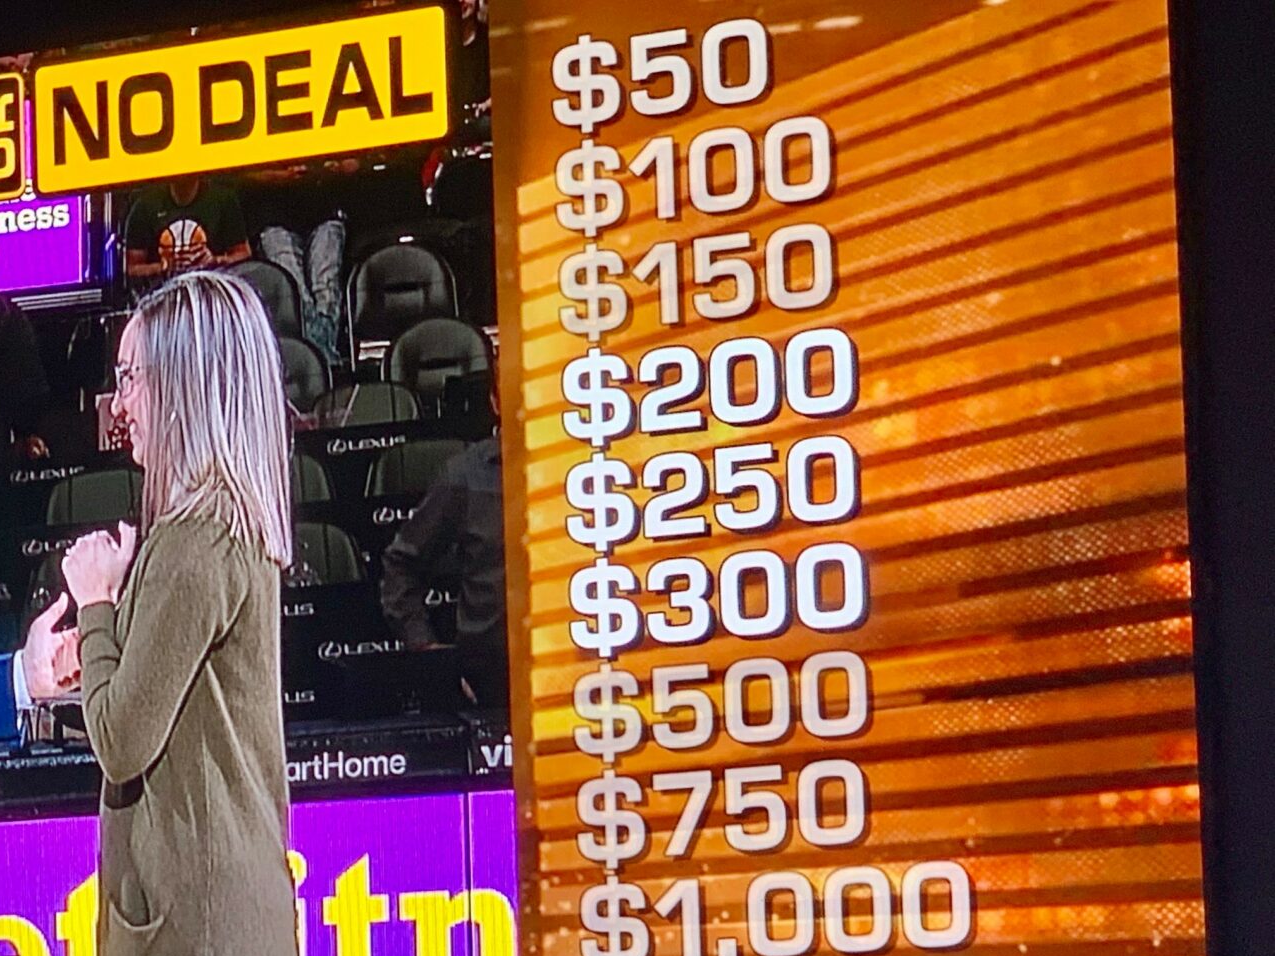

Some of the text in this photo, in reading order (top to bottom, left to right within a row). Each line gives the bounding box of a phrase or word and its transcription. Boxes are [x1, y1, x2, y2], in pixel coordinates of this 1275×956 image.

[52, 71, 175, 166] NO
[199, 34, 435, 144] DEAL
[550, 18, 769, 132] $50
[554, 115, 833, 237] $100
[557, 223, 835, 341] $150
[561, 328, 857, 446] $200
[564, 435, 860, 552] $250
[567, 542, 869, 657] $300
[572, 649, 870, 763] $500
[575, 758, 866, 870] $750
